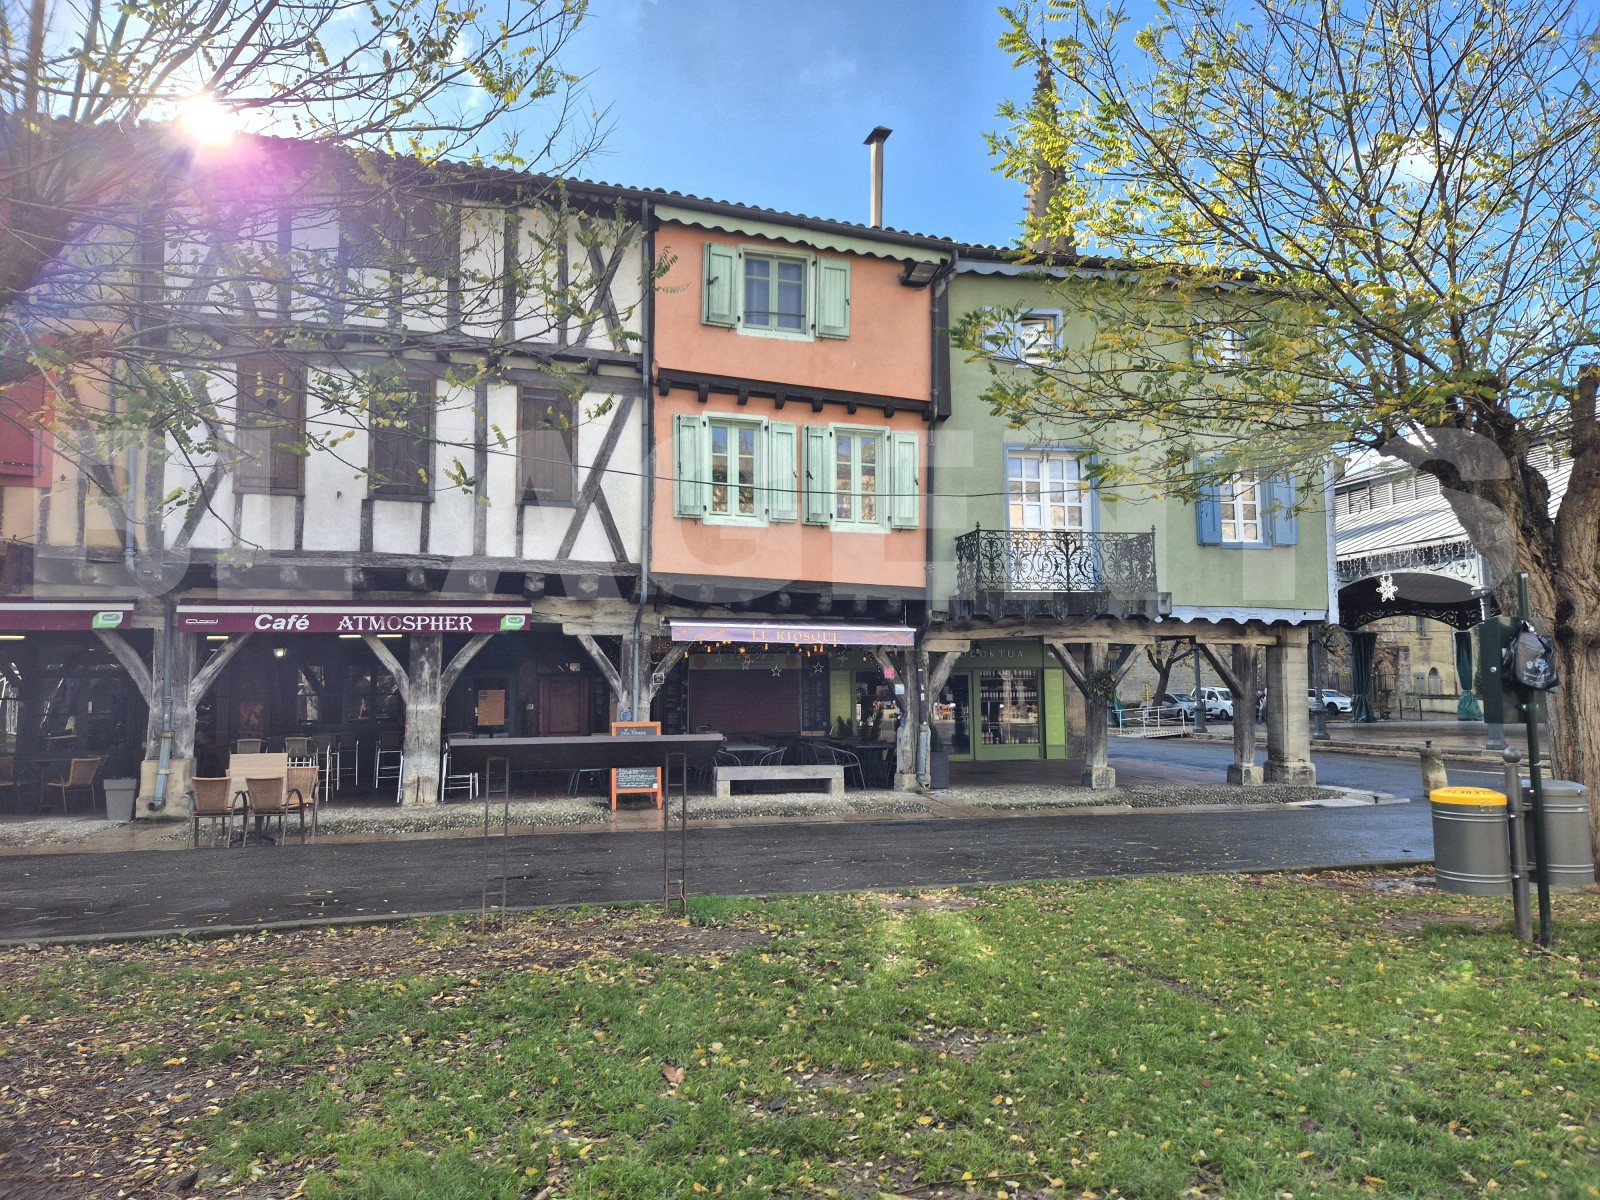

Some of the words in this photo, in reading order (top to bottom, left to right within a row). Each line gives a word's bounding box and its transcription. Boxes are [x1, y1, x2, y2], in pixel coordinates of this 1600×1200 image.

[254, 614, 310, 631] Café
[336, 615, 474, 632] ATMOSPHER
[751, 629, 769, 640] LE
[776, 630, 840, 643] KIOSQUE
